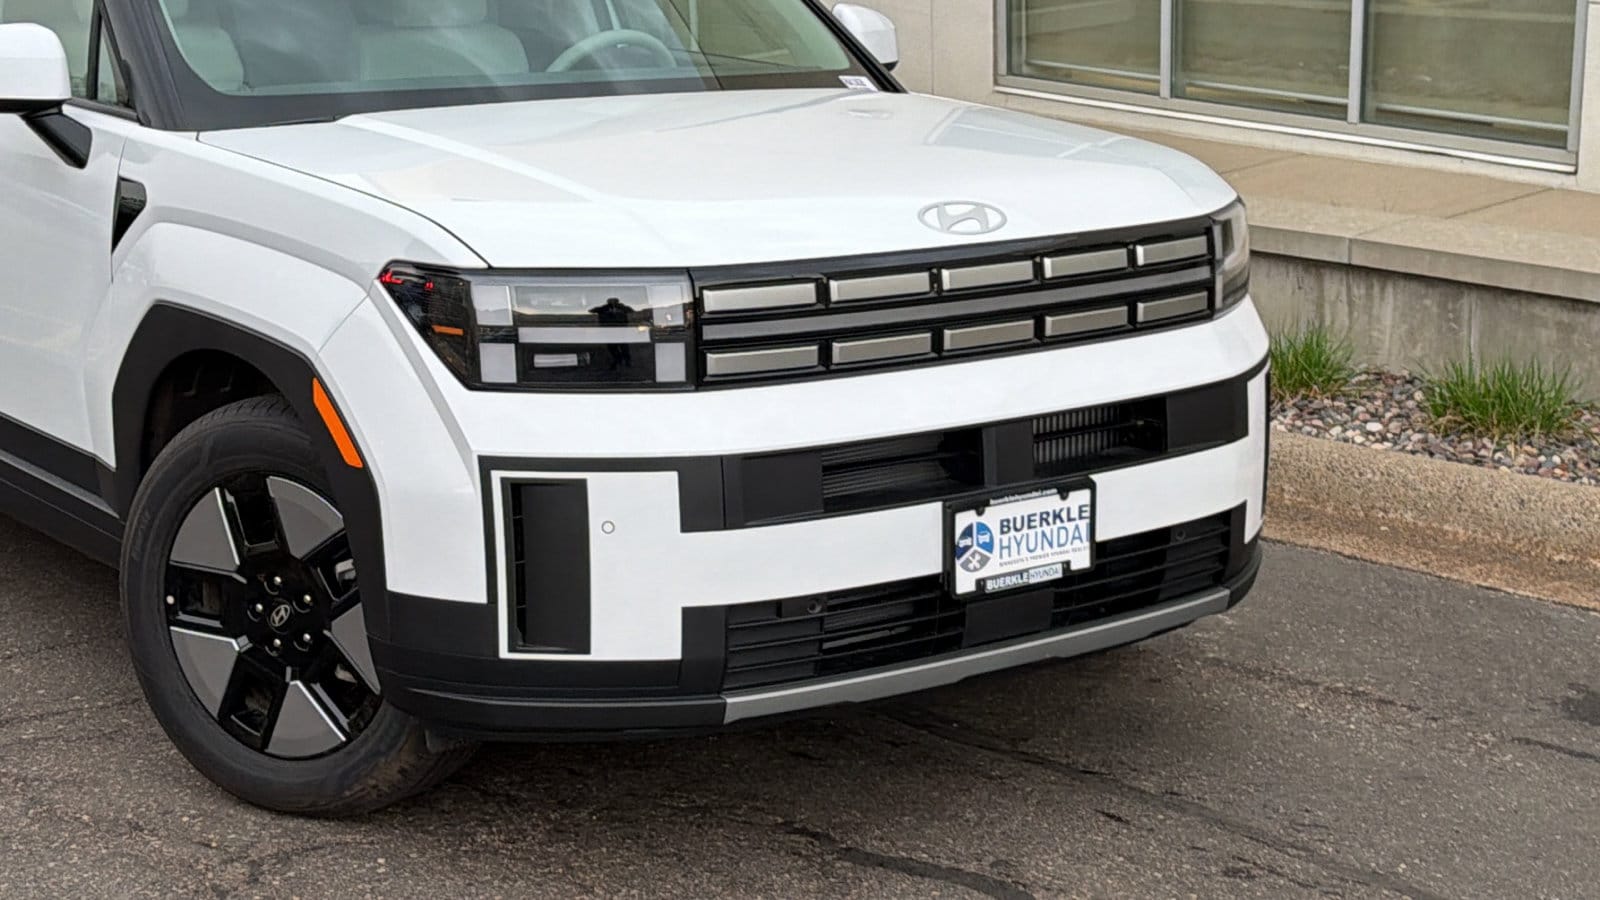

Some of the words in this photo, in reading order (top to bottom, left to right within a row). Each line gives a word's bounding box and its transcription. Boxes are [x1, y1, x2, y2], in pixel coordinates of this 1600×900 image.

[1000, 504, 1089, 535] BUERKLE
[999, 522, 1090, 560] HYUNDAI
[986, 572, 1029, 590] BUERKLE
